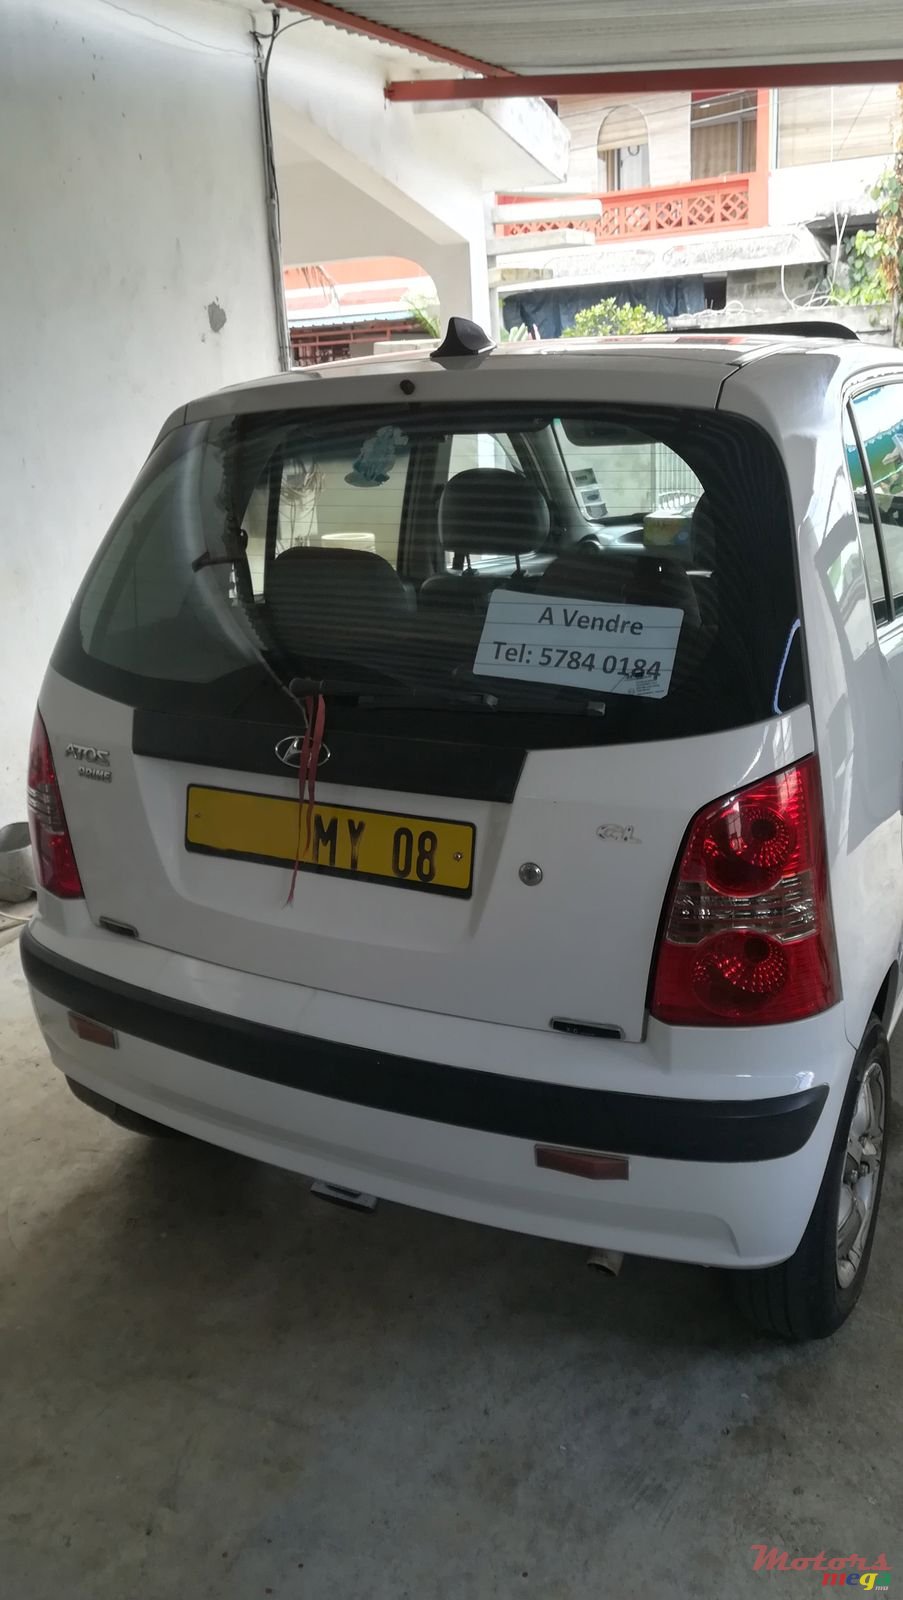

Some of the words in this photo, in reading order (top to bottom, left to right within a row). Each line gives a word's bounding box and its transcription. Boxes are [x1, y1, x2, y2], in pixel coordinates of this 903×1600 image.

[538, 606, 554, 625] A
[563, 608, 644, 636] Vendre
[493, 641, 533, 664] Tel:
[538, 647, 596, 672] 5784
[602, 654, 662, 681] 0184
[391, 826, 438, 883] 08
